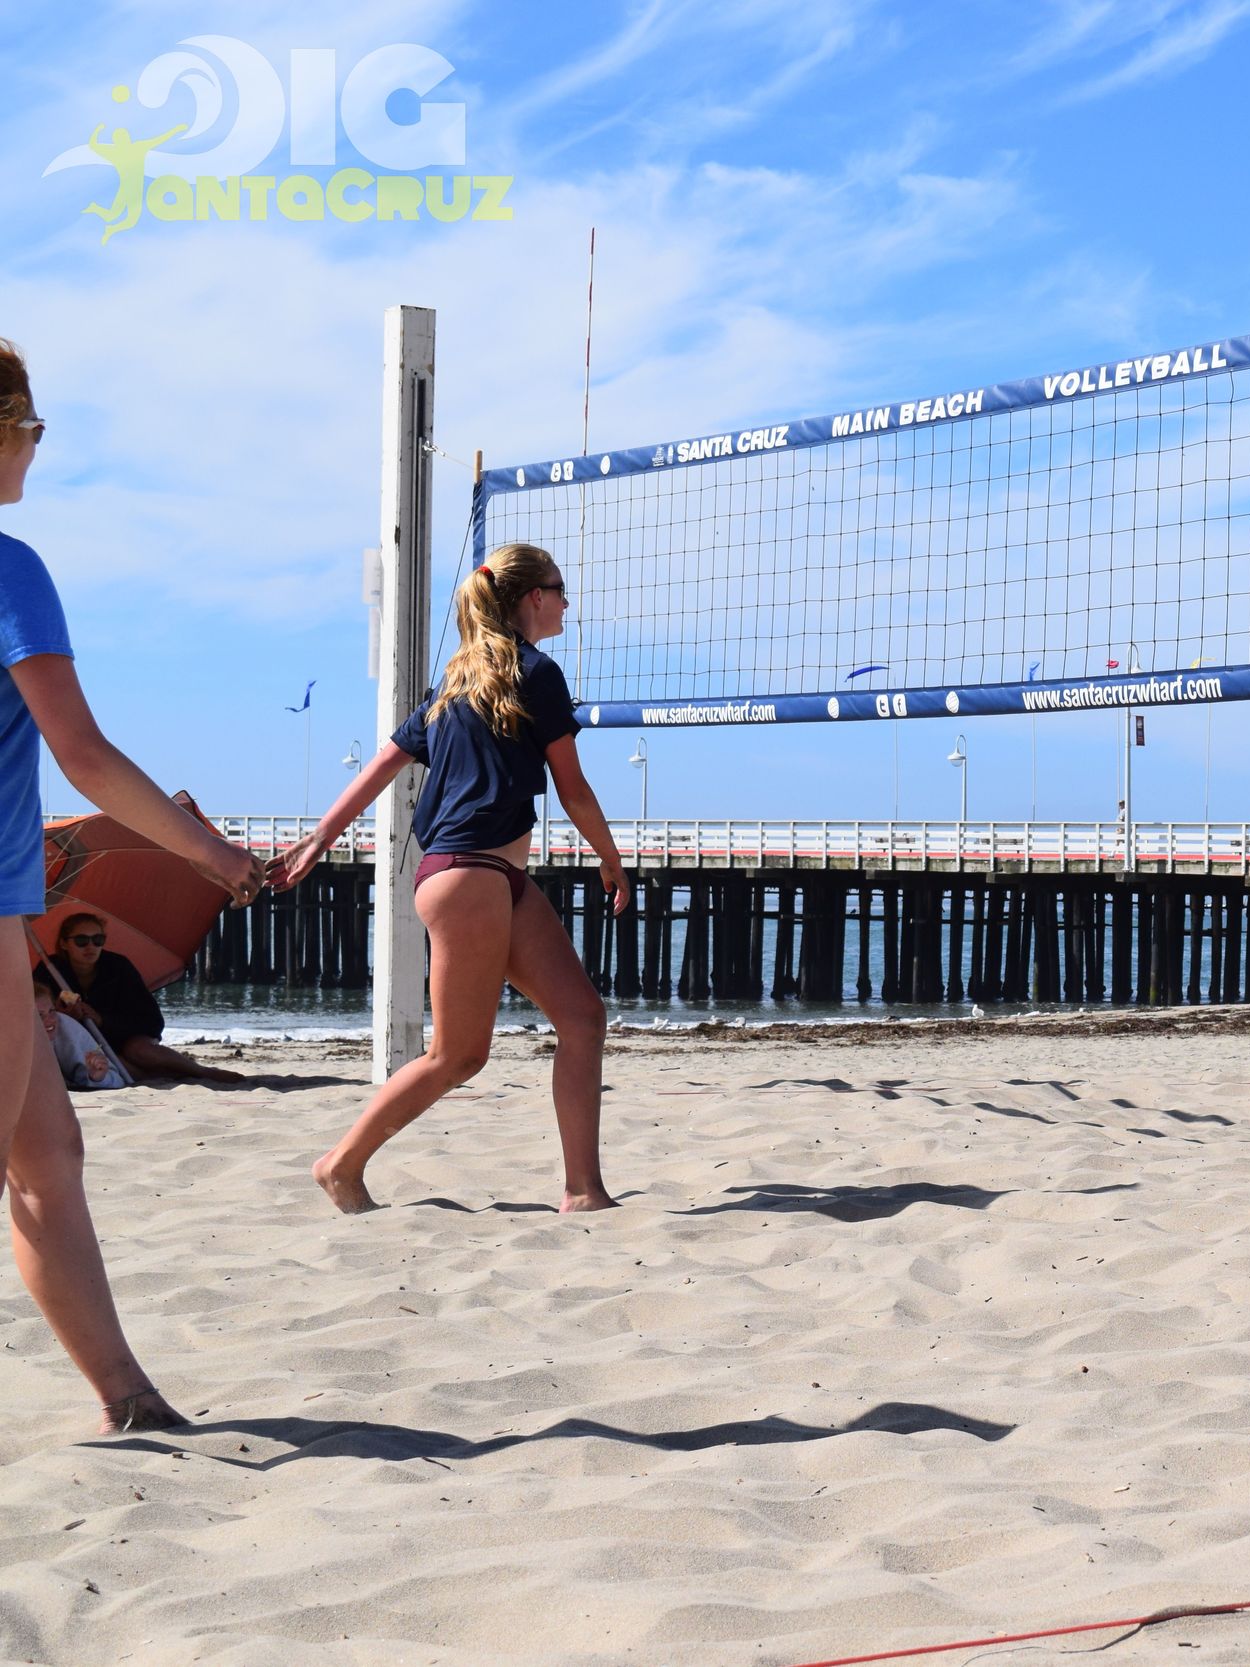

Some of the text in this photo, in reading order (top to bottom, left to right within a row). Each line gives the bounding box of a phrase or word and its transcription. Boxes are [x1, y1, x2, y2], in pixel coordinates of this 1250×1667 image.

[677, 344, 1227, 463] SANTA CRUZ MAIN BEACH VOLLEYBALL
[1021, 674, 1223, 710] www.santacruzwharf.com
[641, 700, 777, 725] www.santacruzwharf.com
